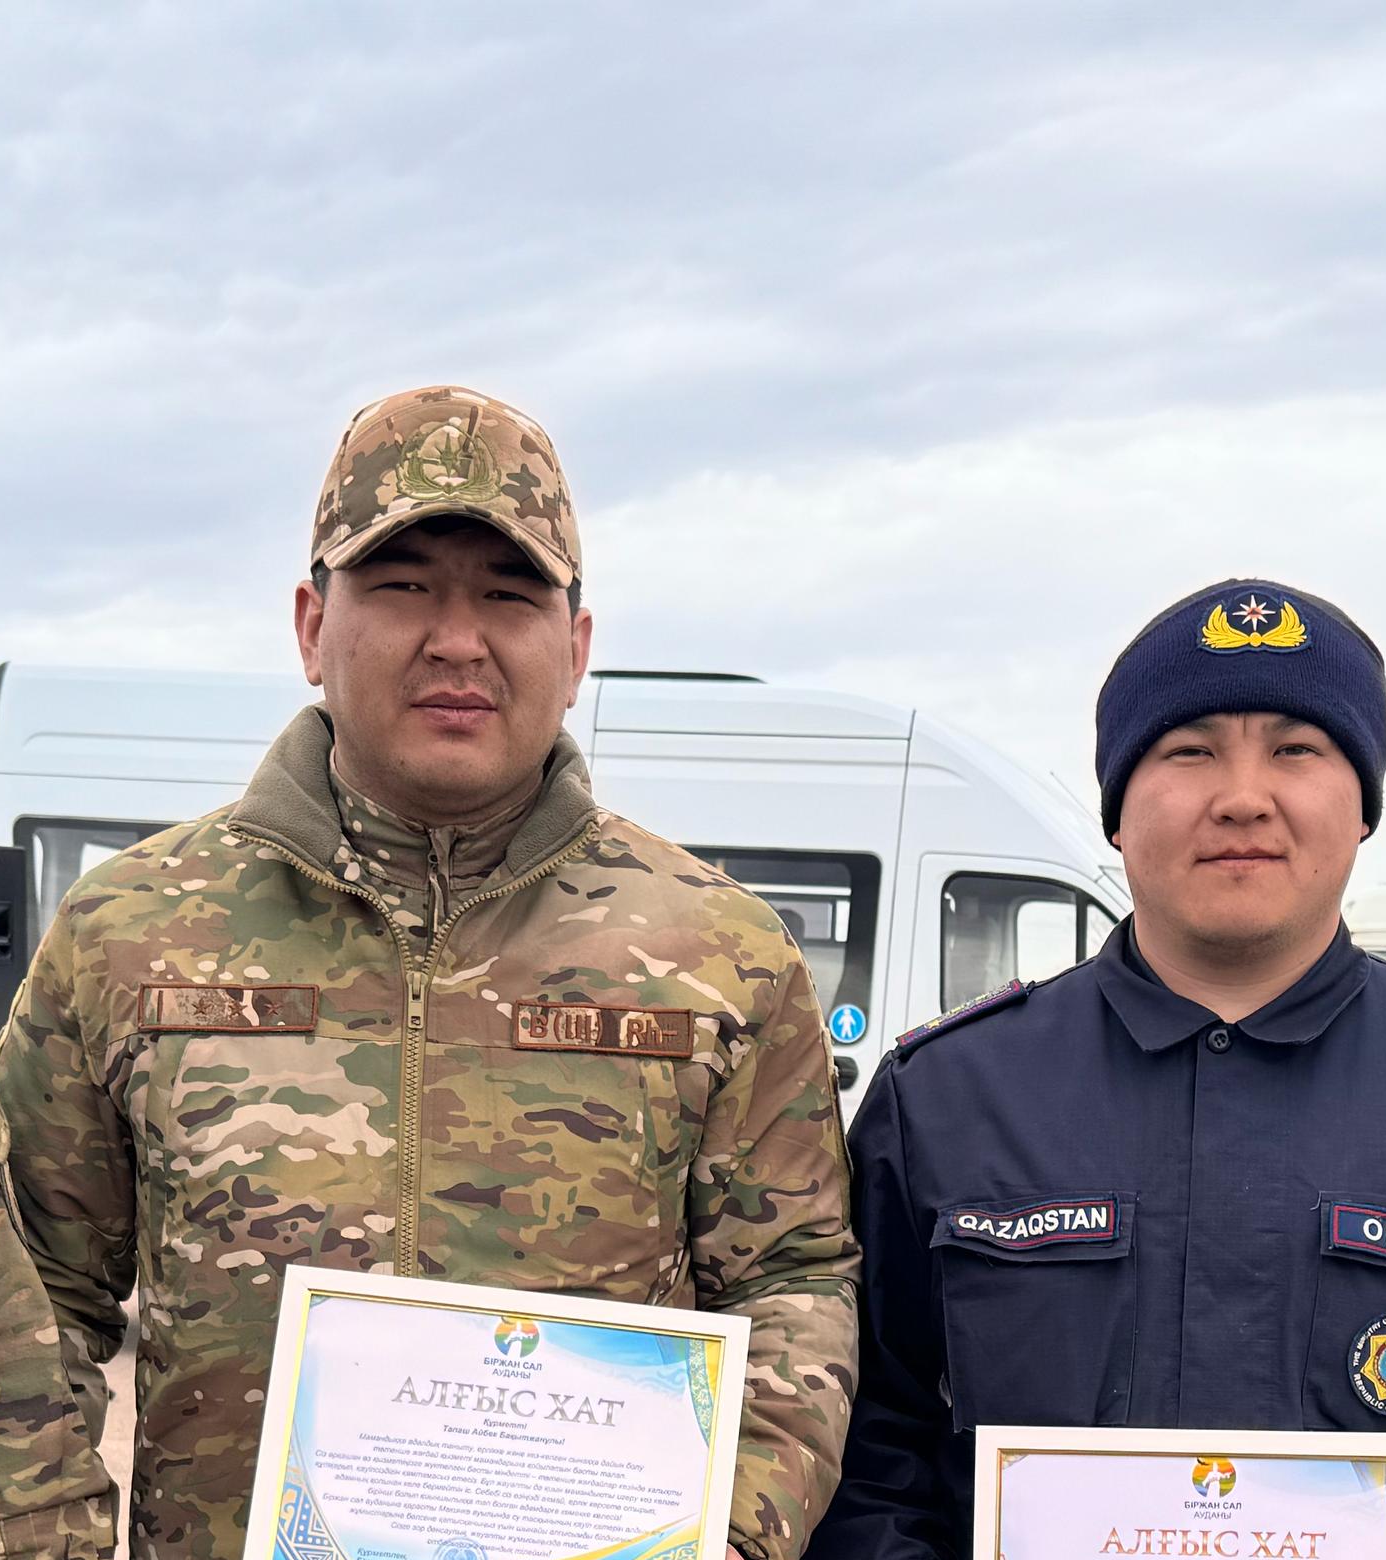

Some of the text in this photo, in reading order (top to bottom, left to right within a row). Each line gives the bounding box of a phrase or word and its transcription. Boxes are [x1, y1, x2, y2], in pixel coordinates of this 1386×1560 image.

[957, 1206, 1109, 1240] QAZAQSTAN
[483, 1357, 542, 1370] БІРЖАН САЛ
[1353, 1352, 1361, 1367] THE
[492, 1368, 531, 1379] АУДАНЫ
[1353, 1373, 1384, 1409] REPUBLIC
[391, 1374, 624, 1428] АЛҒЫС ХАТ
[1184, 1501, 1219, 1509] БІРЖАН
[1193, 1511, 1231, 1519] АУДАНЫ
[1098, 1527, 1327, 1559] АЛҒЫС ХАТ
